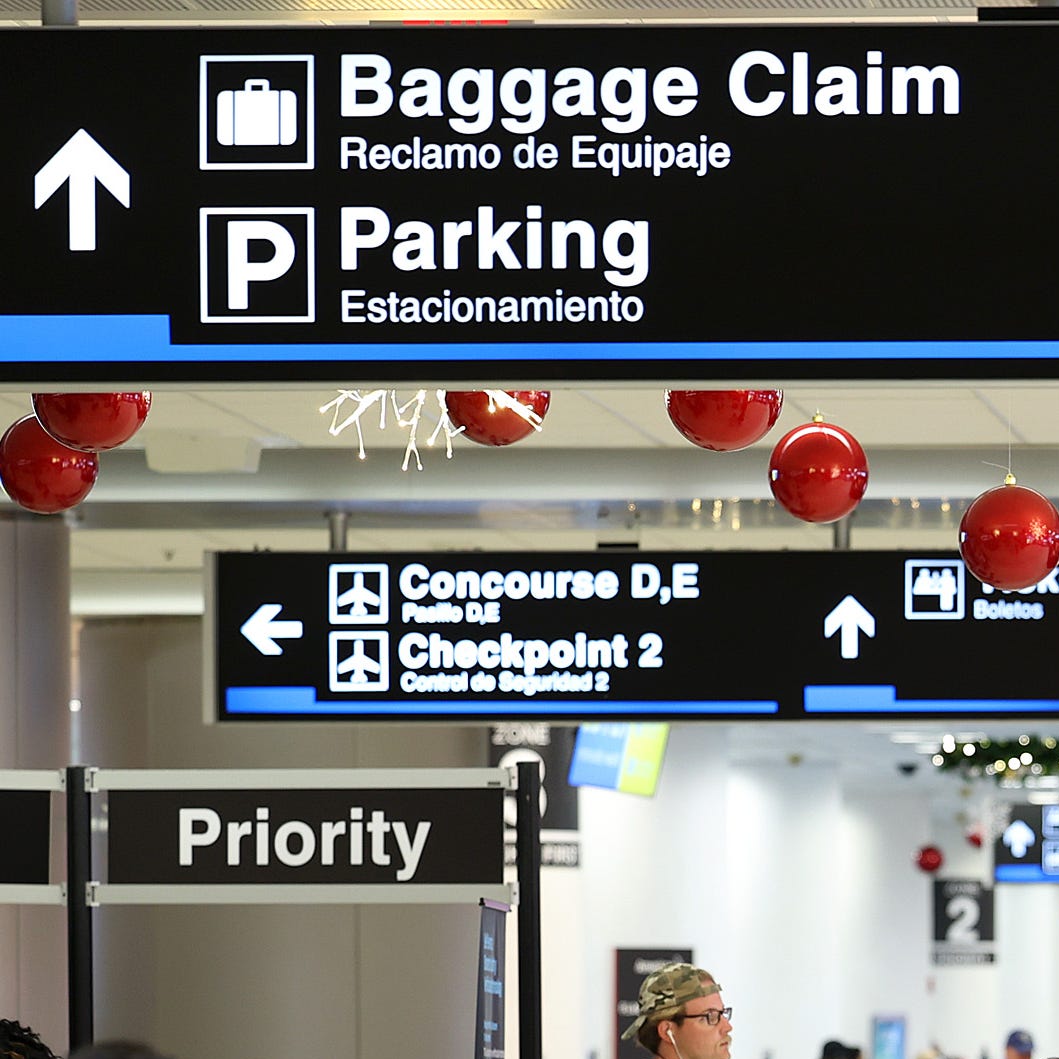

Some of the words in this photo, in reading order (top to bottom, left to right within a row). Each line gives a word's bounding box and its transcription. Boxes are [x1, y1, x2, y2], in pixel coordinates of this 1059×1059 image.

[340, 53, 699, 132] Baggage
[728, 50, 960, 116] Claim
[340, 136, 501, 170] Reclamo
[512, 136, 559, 170] de
[571, 136, 731, 177] Equipaje
[227, 220, 296, 310] P
[340, 205, 649, 288] Parking
[341, 289, 644, 324] Estacionamiento
[399, 563, 618, 600] Concourse
[630, 563, 700, 604] D,E
[972, 598, 1045, 620] Boletos
[398, 632, 629, 674] Checkpoint
[638, 632, 663, 668] 2
[400, 671, 469, 692] Control
[470, 671, 497, 692] de
[498, 671, 593, 697] Seguridad
[594, 671, 611, 693] 2
[178, 806, 432, 882] Priority
[945, 896, 981, 944] 2
